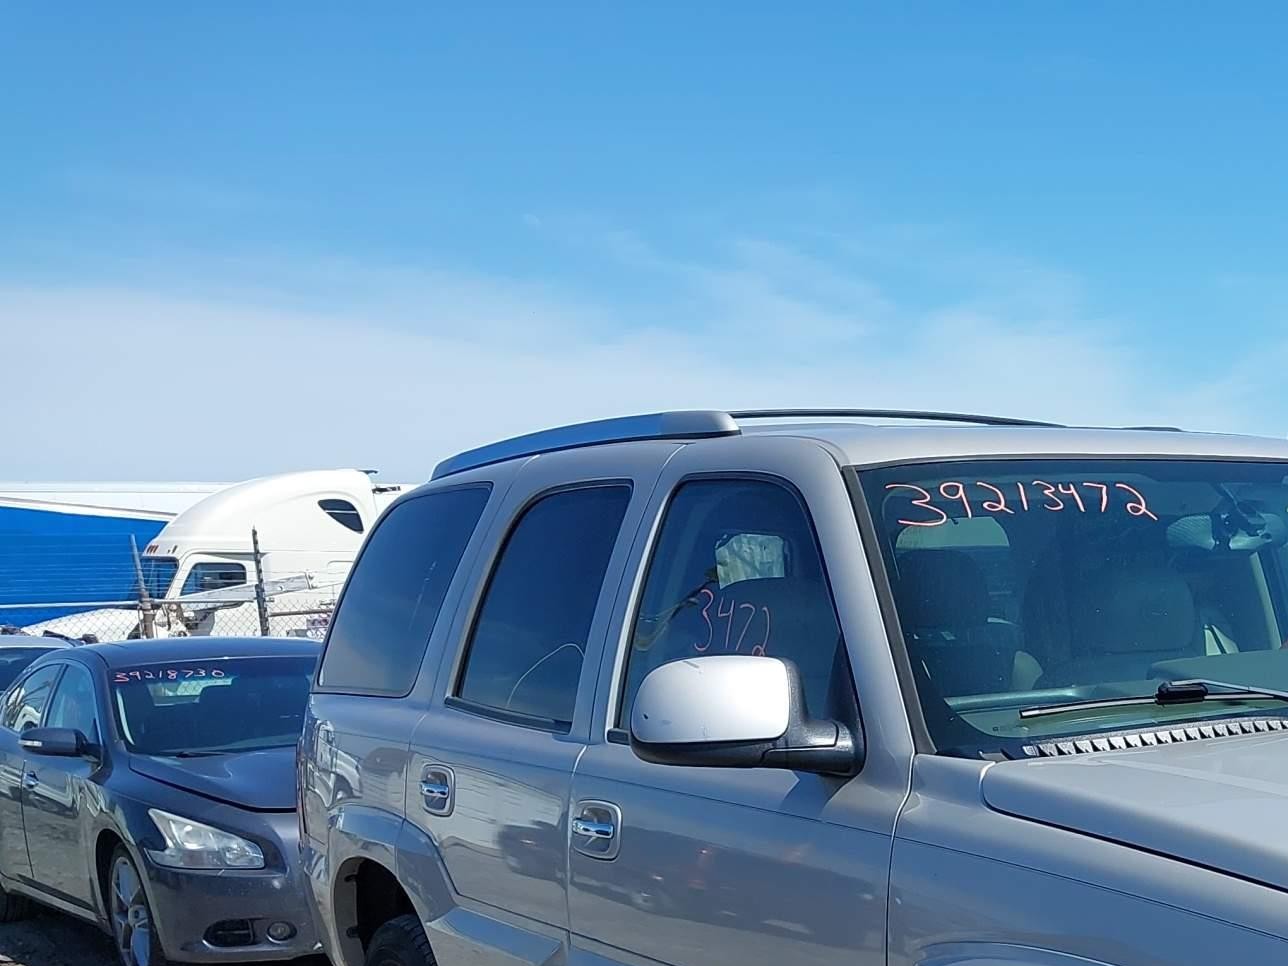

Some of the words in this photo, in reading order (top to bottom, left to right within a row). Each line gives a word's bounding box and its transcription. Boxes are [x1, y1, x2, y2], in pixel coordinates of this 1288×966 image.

[885, 480, 1159, 527] 39213472
[693, 588, 770, 657] 3472
[113, 668, 225, 682] 39218730
